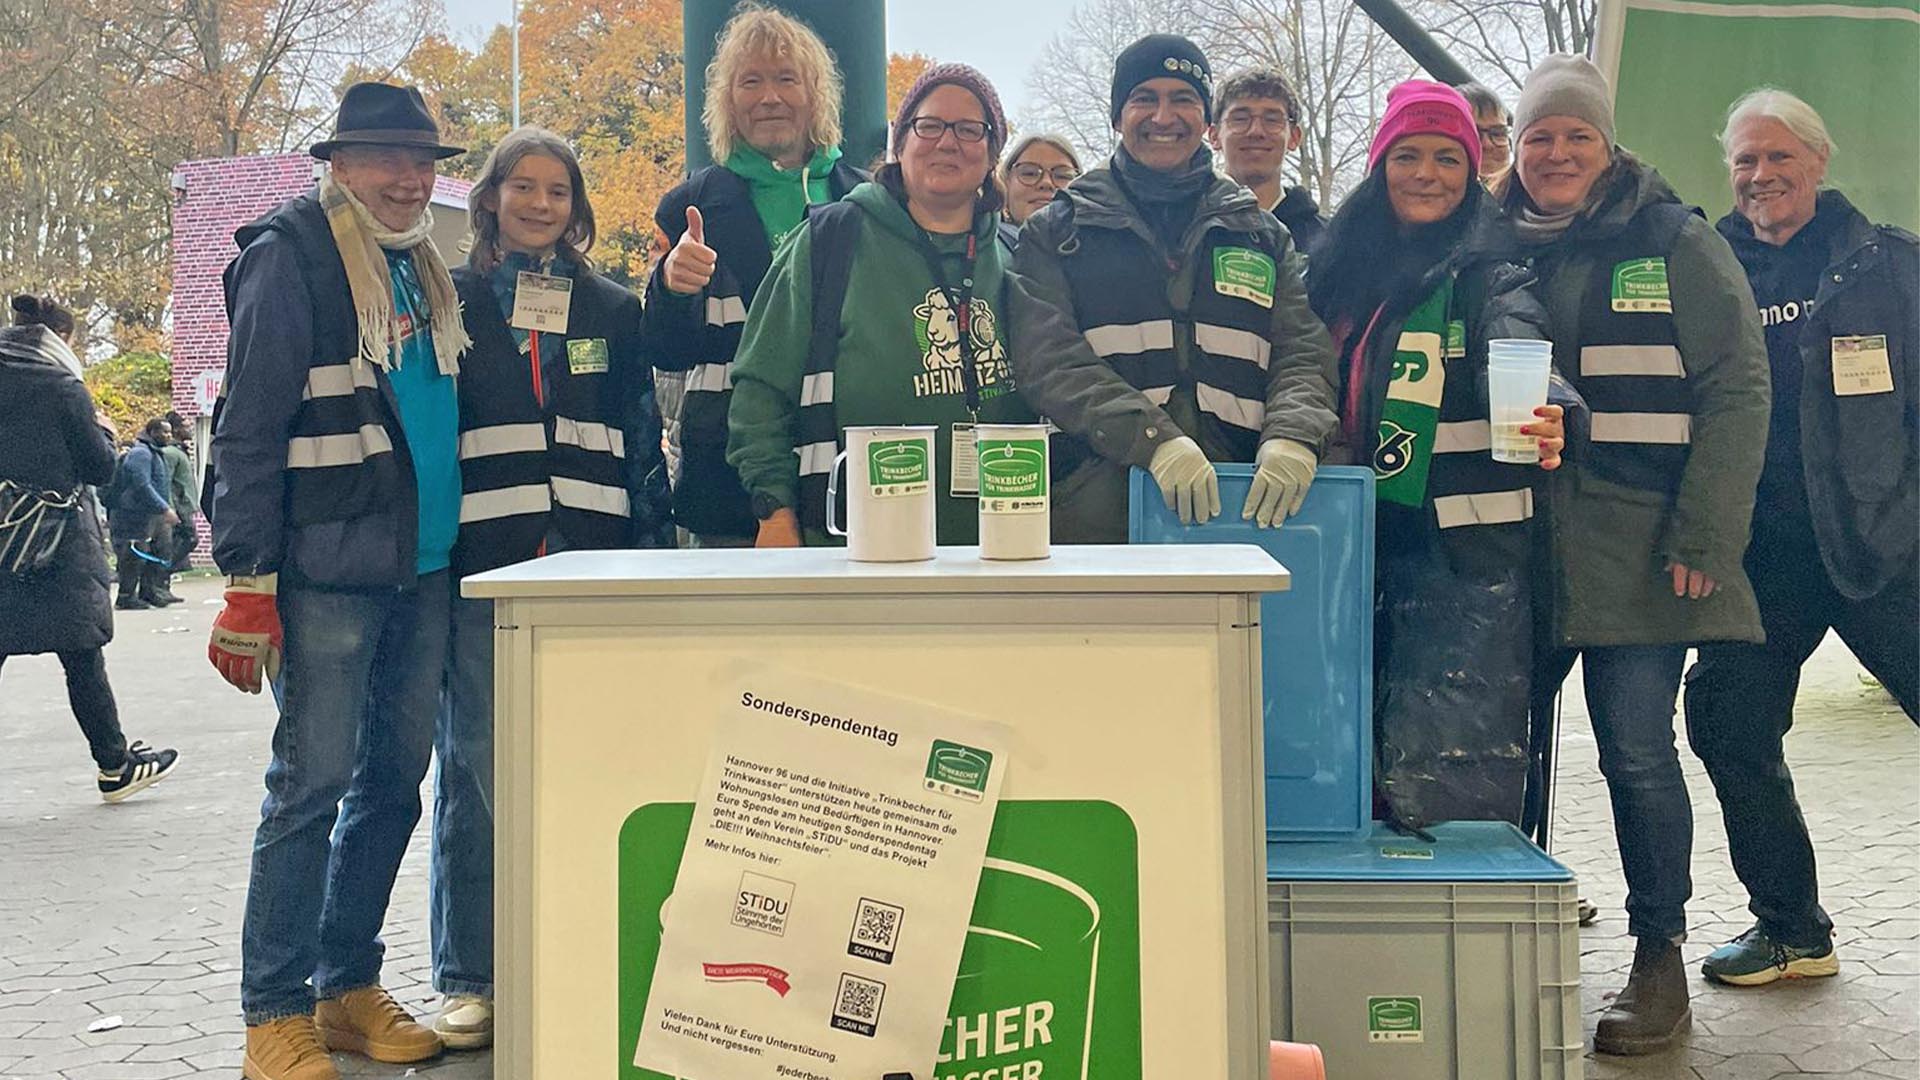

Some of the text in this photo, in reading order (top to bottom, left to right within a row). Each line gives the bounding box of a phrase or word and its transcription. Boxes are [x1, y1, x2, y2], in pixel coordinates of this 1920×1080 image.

[984, 472, 1038, 485] TRINKBECHER
[741, 692, 898, 747] Sonderspendentag
[726, 755, 773, 775] Hannover
[776, 767, 788, 778] 96
[790, 773, 809, 784] und
[811, 777, 826, 788] die
[829, 781, 870, 799] Initiative
[938, 809, 953, 821] für
[716, 793, 937, 859] Eure Spende am heutigen Sonderspendentag
[720, 781, 944, 846] Wohnungslosen und Bedürftigen in Hannover.
[789, 784, 851, 808] unterstützen
[853, 801, 881, 815] heute
[883, 810, 939, 831] gemeinsam
[942, 824, 957, 835] die
[704, 838, 782, 865] Mehr Infos hier:
[713, 807, 736, 819] geht
[737, 813, 750, 822] an
[752, 815, 771, 828] den
[773, 821, 804, 837] Verein
[849, 841, 869, 853] und
[871, 846, 889, 858] das
[891, 850, 928, 868] Projekt
[736, 906, 784, 925] Stimme der
[739, 891, 788, 915] STiDU
[734, 915, 782, 933] Ungehörten
[853, 945, 888, 961] SCAN ME
[660, 1020, 765, 1056] Und nicht vergessen:
[663, 1008, 838, 1063] Vielen Dank für Eure Unterstützung.
[836, 1018, 871, 1034] SCAN ME
